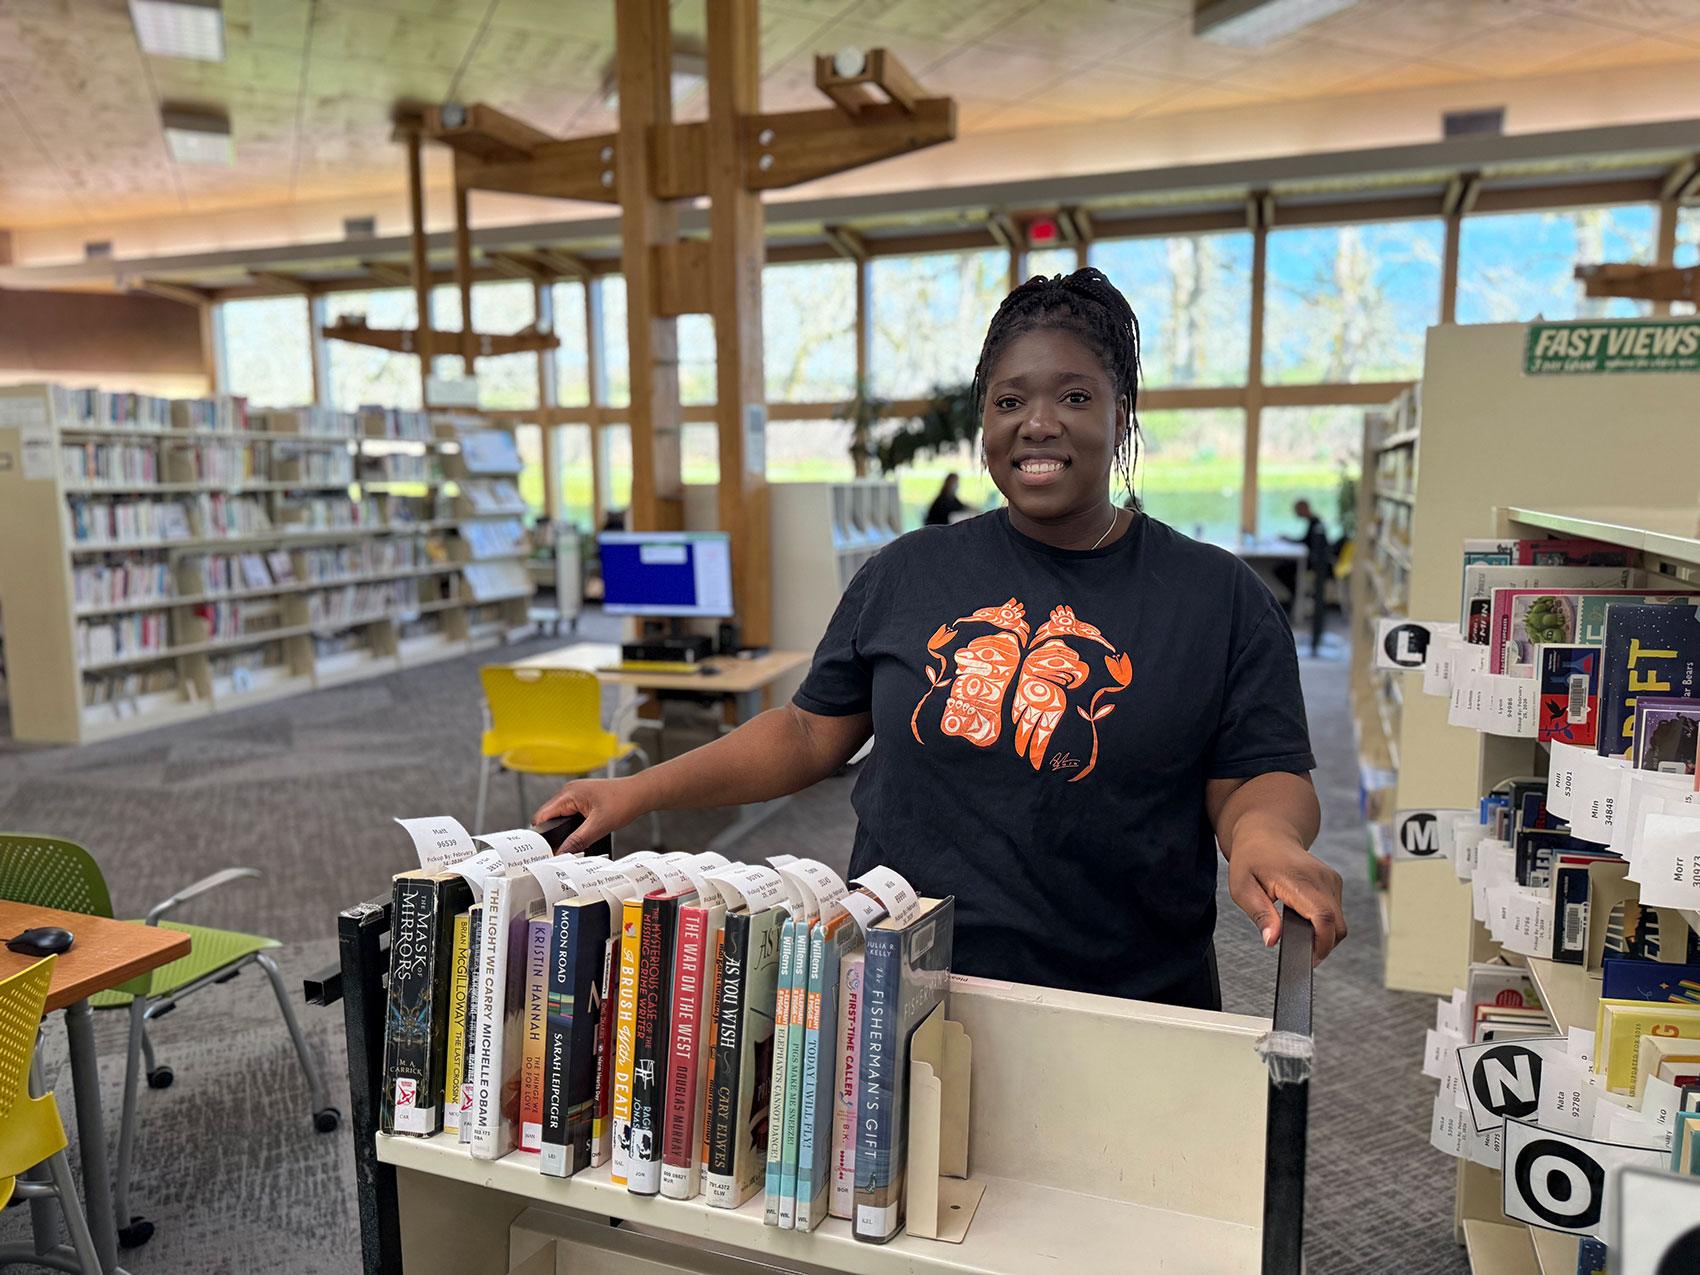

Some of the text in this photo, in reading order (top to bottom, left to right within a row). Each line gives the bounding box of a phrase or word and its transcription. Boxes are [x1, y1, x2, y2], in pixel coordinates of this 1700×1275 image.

[1396, 630, 1424, 662] L
[1682, 661, 1694, 686] Bears
[1565, 771, 1573, 797] 53001
[1605, 798, 1614, 826] 34848
[453, 850, 474, 858] February
[1405, 820, 1440, 851] M
[1674, 857, 1684, 881] Morr
[394, 890, 419, 980] MIRRORS
[411, 911, 432, 973] MASK
[483, 889, 499, 1020] THE LIGHT WE CARRY
[557, 909, 570, 983] MOON ROAD
[867, 941, 887, 950] JULIA
[870, 949, 892, 957] KELLY
[417, 967, 423, 977] OF
[624, 947, 634, 964] A
[649, 921, 661, 990] MYSTERIOUS
[781, 936, 793, 976] Willems
[796, 935, 807, 975] Willems
[811, 940, 822, 979] Willems
[530, 927, 546, 1041] KRISTIN HANNAH
[620, 966, 635, 1021] BRUSH
[636, 914, 651, 1039] MISSING CRIME WRITER
[676, 917, 700, 1059] THE WAR ON THE WEST
[646, 992, 658, 1020] CASE
[720, 952, 741, 1049] AS YOU WISH
[618, 1025, 631, 1066] With
[645, 1022, 653, 1034] OF
[844, 993, 857, 1097] FIRST-TIME CALLER
[390, 1066, 423, 1076] CARRICK
[480, 1023, 492, 1087] MICHELLE
[775, 1029, 785, 1084] ELEPHANTS
[806, 1039, 817, 1082] TODAY
[864, 967, 884, 1159] The FISHERMAN'S GIFT
[452, 1068, 461, 1104] CROSSIN
[524, 1057, 533, 1111] DO FOR LOVE
[532, 1073, 540, 1101] THINGS
[549, 1033, 563, 1129] SARAH LEIPCIGER
[787, 1042, 800, 1146] PIGS MAKE ME SNEEZE!
[1482, 1054, 1536, 1108] N
[478, 1089, 489, 1127] OBAM
[531, 1104, 539, 1113] WE
[632, 1097, 641, 1128] JÓNAS
[671, 1065, 688, 1158] DOUGLAS MURRAY
[772, 1085, 782, 1122] CANNOT
[804, 1090, 815, 1122] WILL
[1557, 1091, 1565, 1111] Nata
[1572, 1091, 1581, 1118] 92780
[715, 1086, 730, 1168] CARY ELWES
[769, 1124, 780, 1159] DANCE!
[802, 1122, 813, 1149] FLY!
[1529, 1155, 1592, 1216] O
